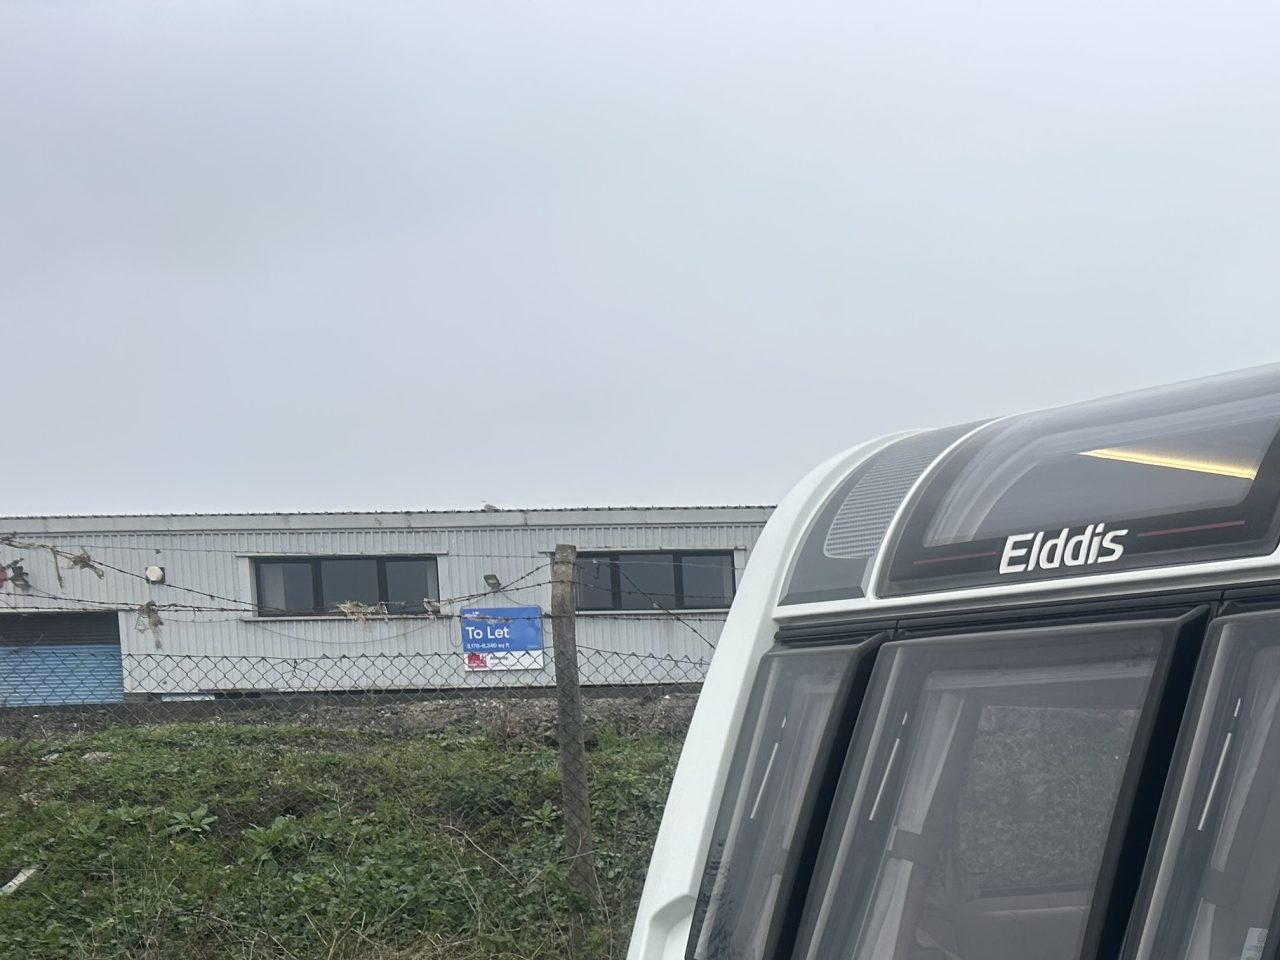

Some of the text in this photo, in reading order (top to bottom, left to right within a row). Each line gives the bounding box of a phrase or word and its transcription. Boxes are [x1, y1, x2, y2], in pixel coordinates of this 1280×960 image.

[999, 523, 1129, 574] Elddis
[465, 626, 510, 639] To Let
